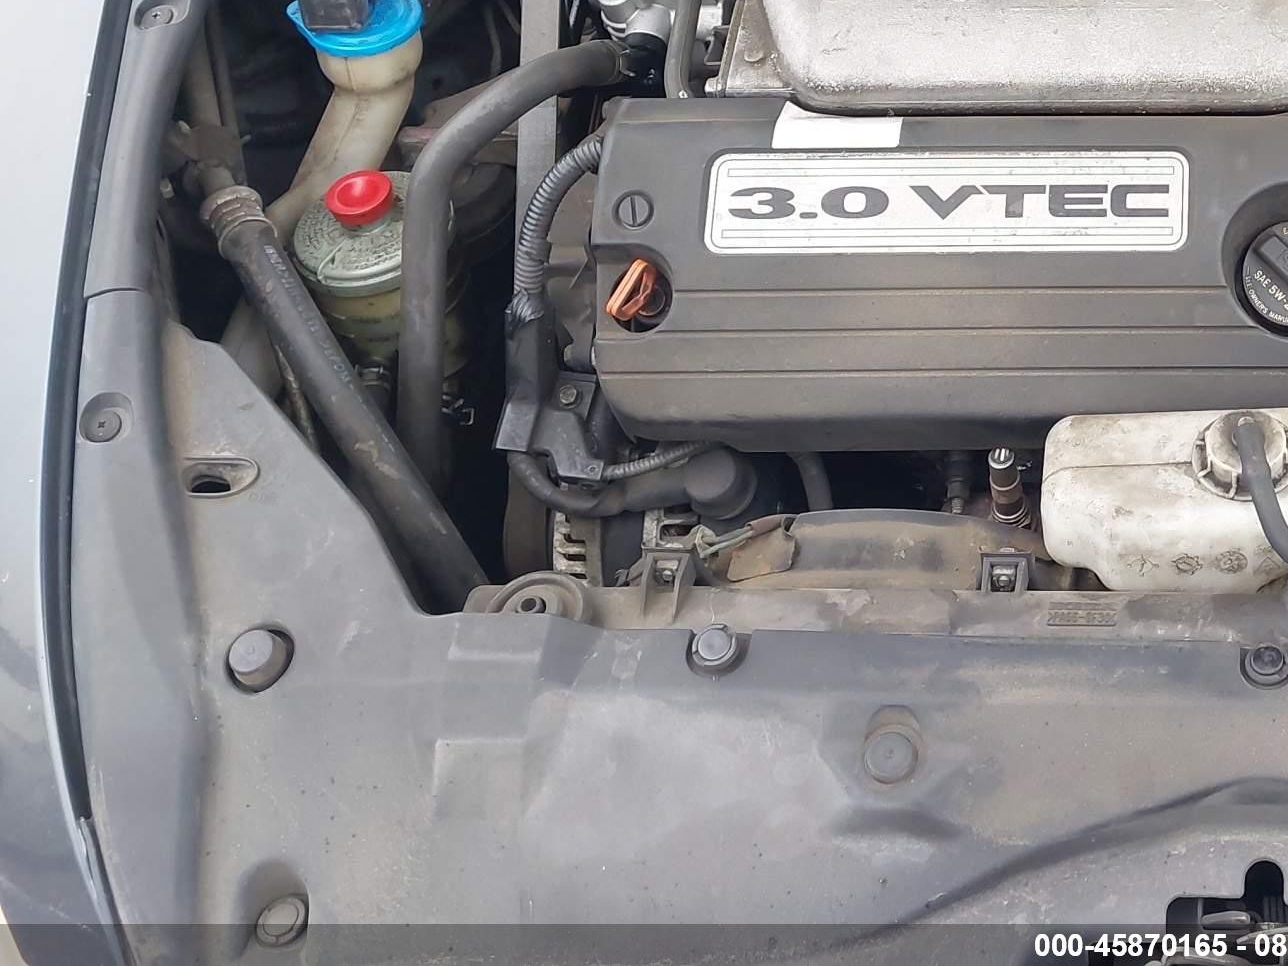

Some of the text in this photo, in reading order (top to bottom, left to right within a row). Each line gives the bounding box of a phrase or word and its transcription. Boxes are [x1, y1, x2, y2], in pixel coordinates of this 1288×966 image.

[728, 184, 1170, 220] 3.0 VTEC
[1254, 270, 1272, 288] SAE
